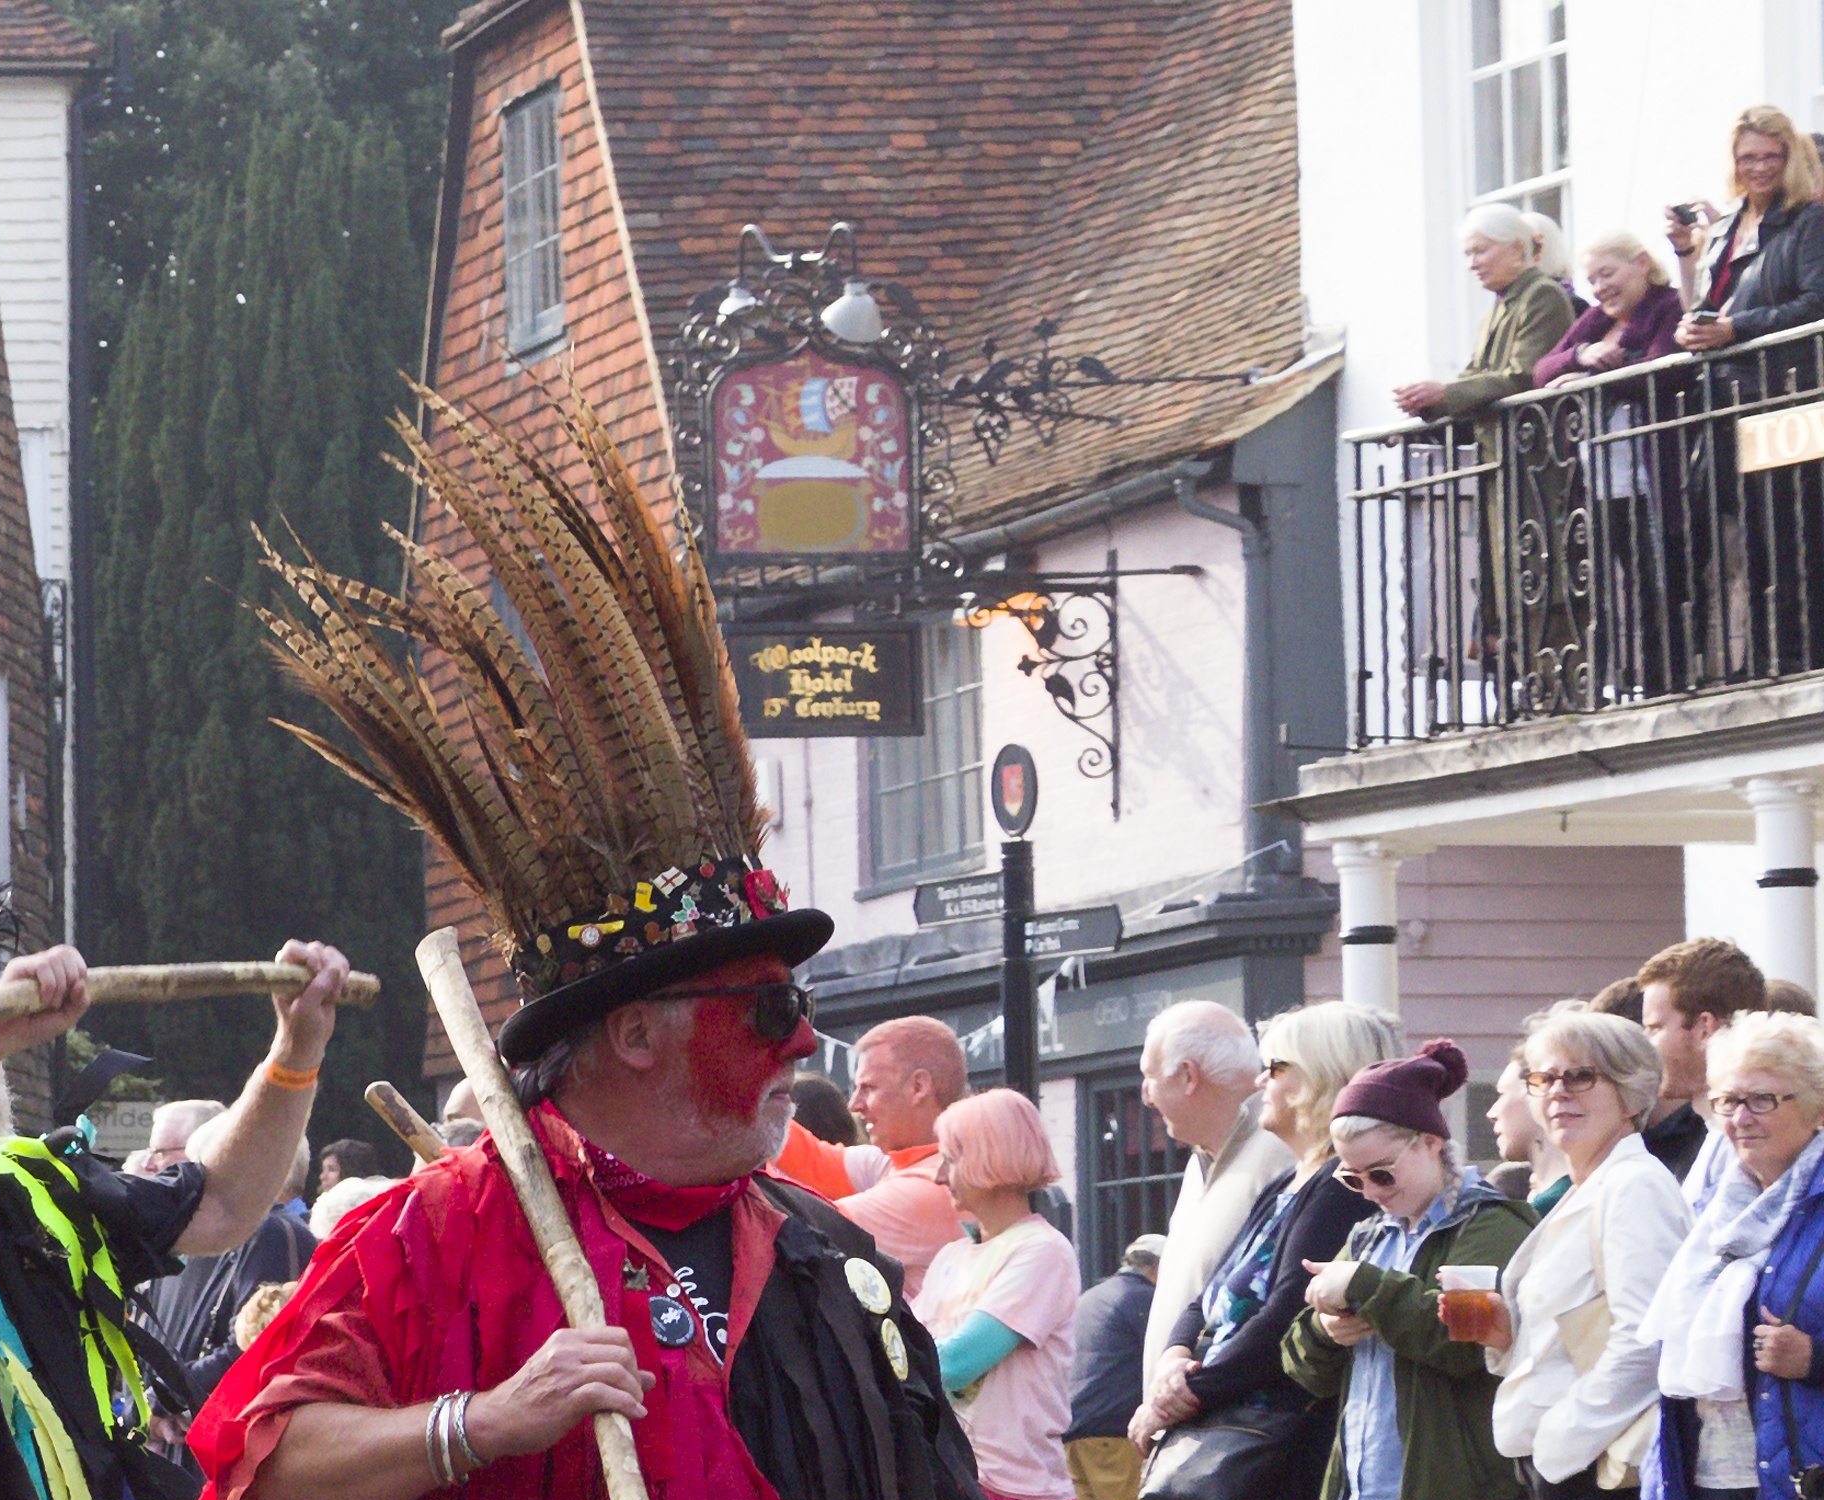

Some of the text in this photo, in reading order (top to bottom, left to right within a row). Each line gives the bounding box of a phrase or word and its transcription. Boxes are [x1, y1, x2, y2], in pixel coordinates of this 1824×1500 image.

[749, 636, 880, 674] Woolpack
[787, 668, 854, 697] Hotel
[794, 696, 881, 722] Century
